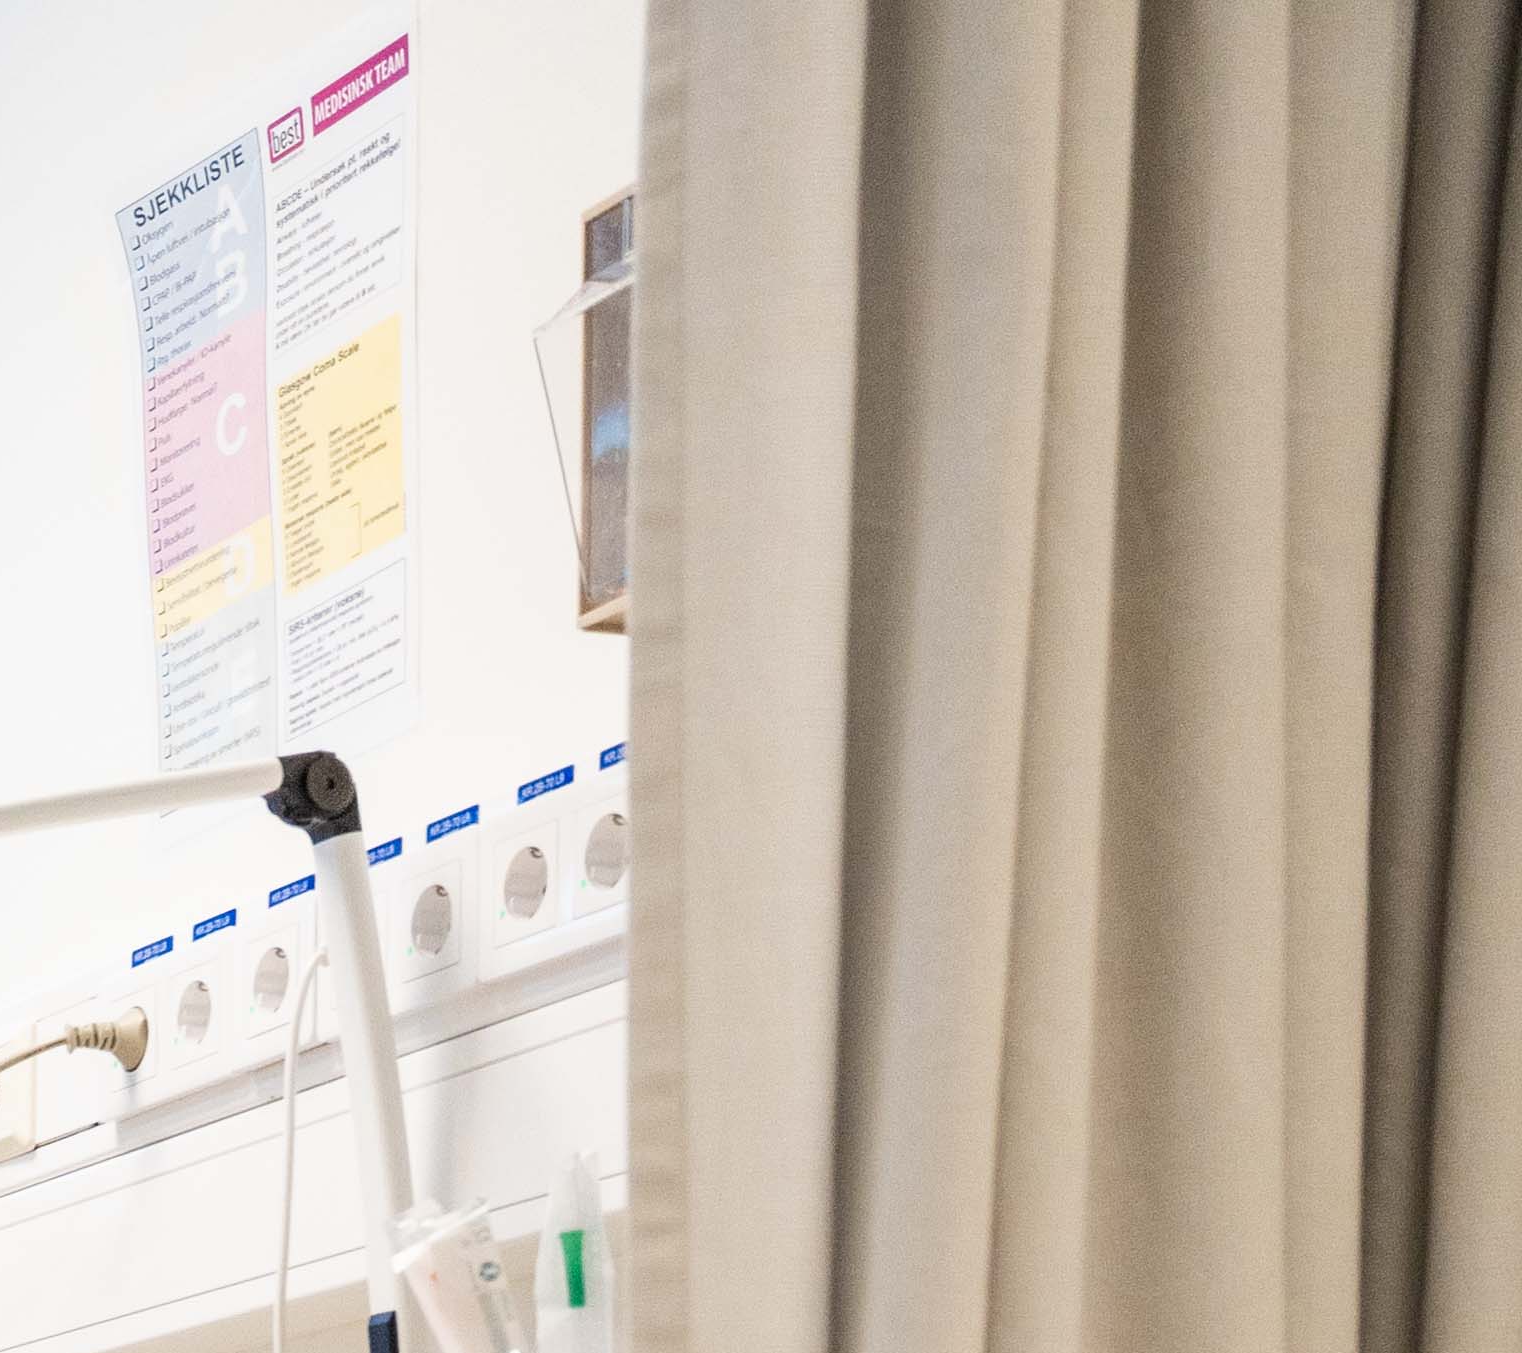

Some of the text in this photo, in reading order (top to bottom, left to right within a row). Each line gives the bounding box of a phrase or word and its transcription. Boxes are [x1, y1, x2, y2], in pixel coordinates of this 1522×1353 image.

[314, 48, 406, 126] MEDISINSK TEAM
[271, 118, 301, 154] best
[133, 144, 245, 227] SJEKKLISTE
[149, 262, 181, 286] Blodgass
[278, 343, 360, 398] Glasgow Coma Scale
[217, 392, 248, 457] C
